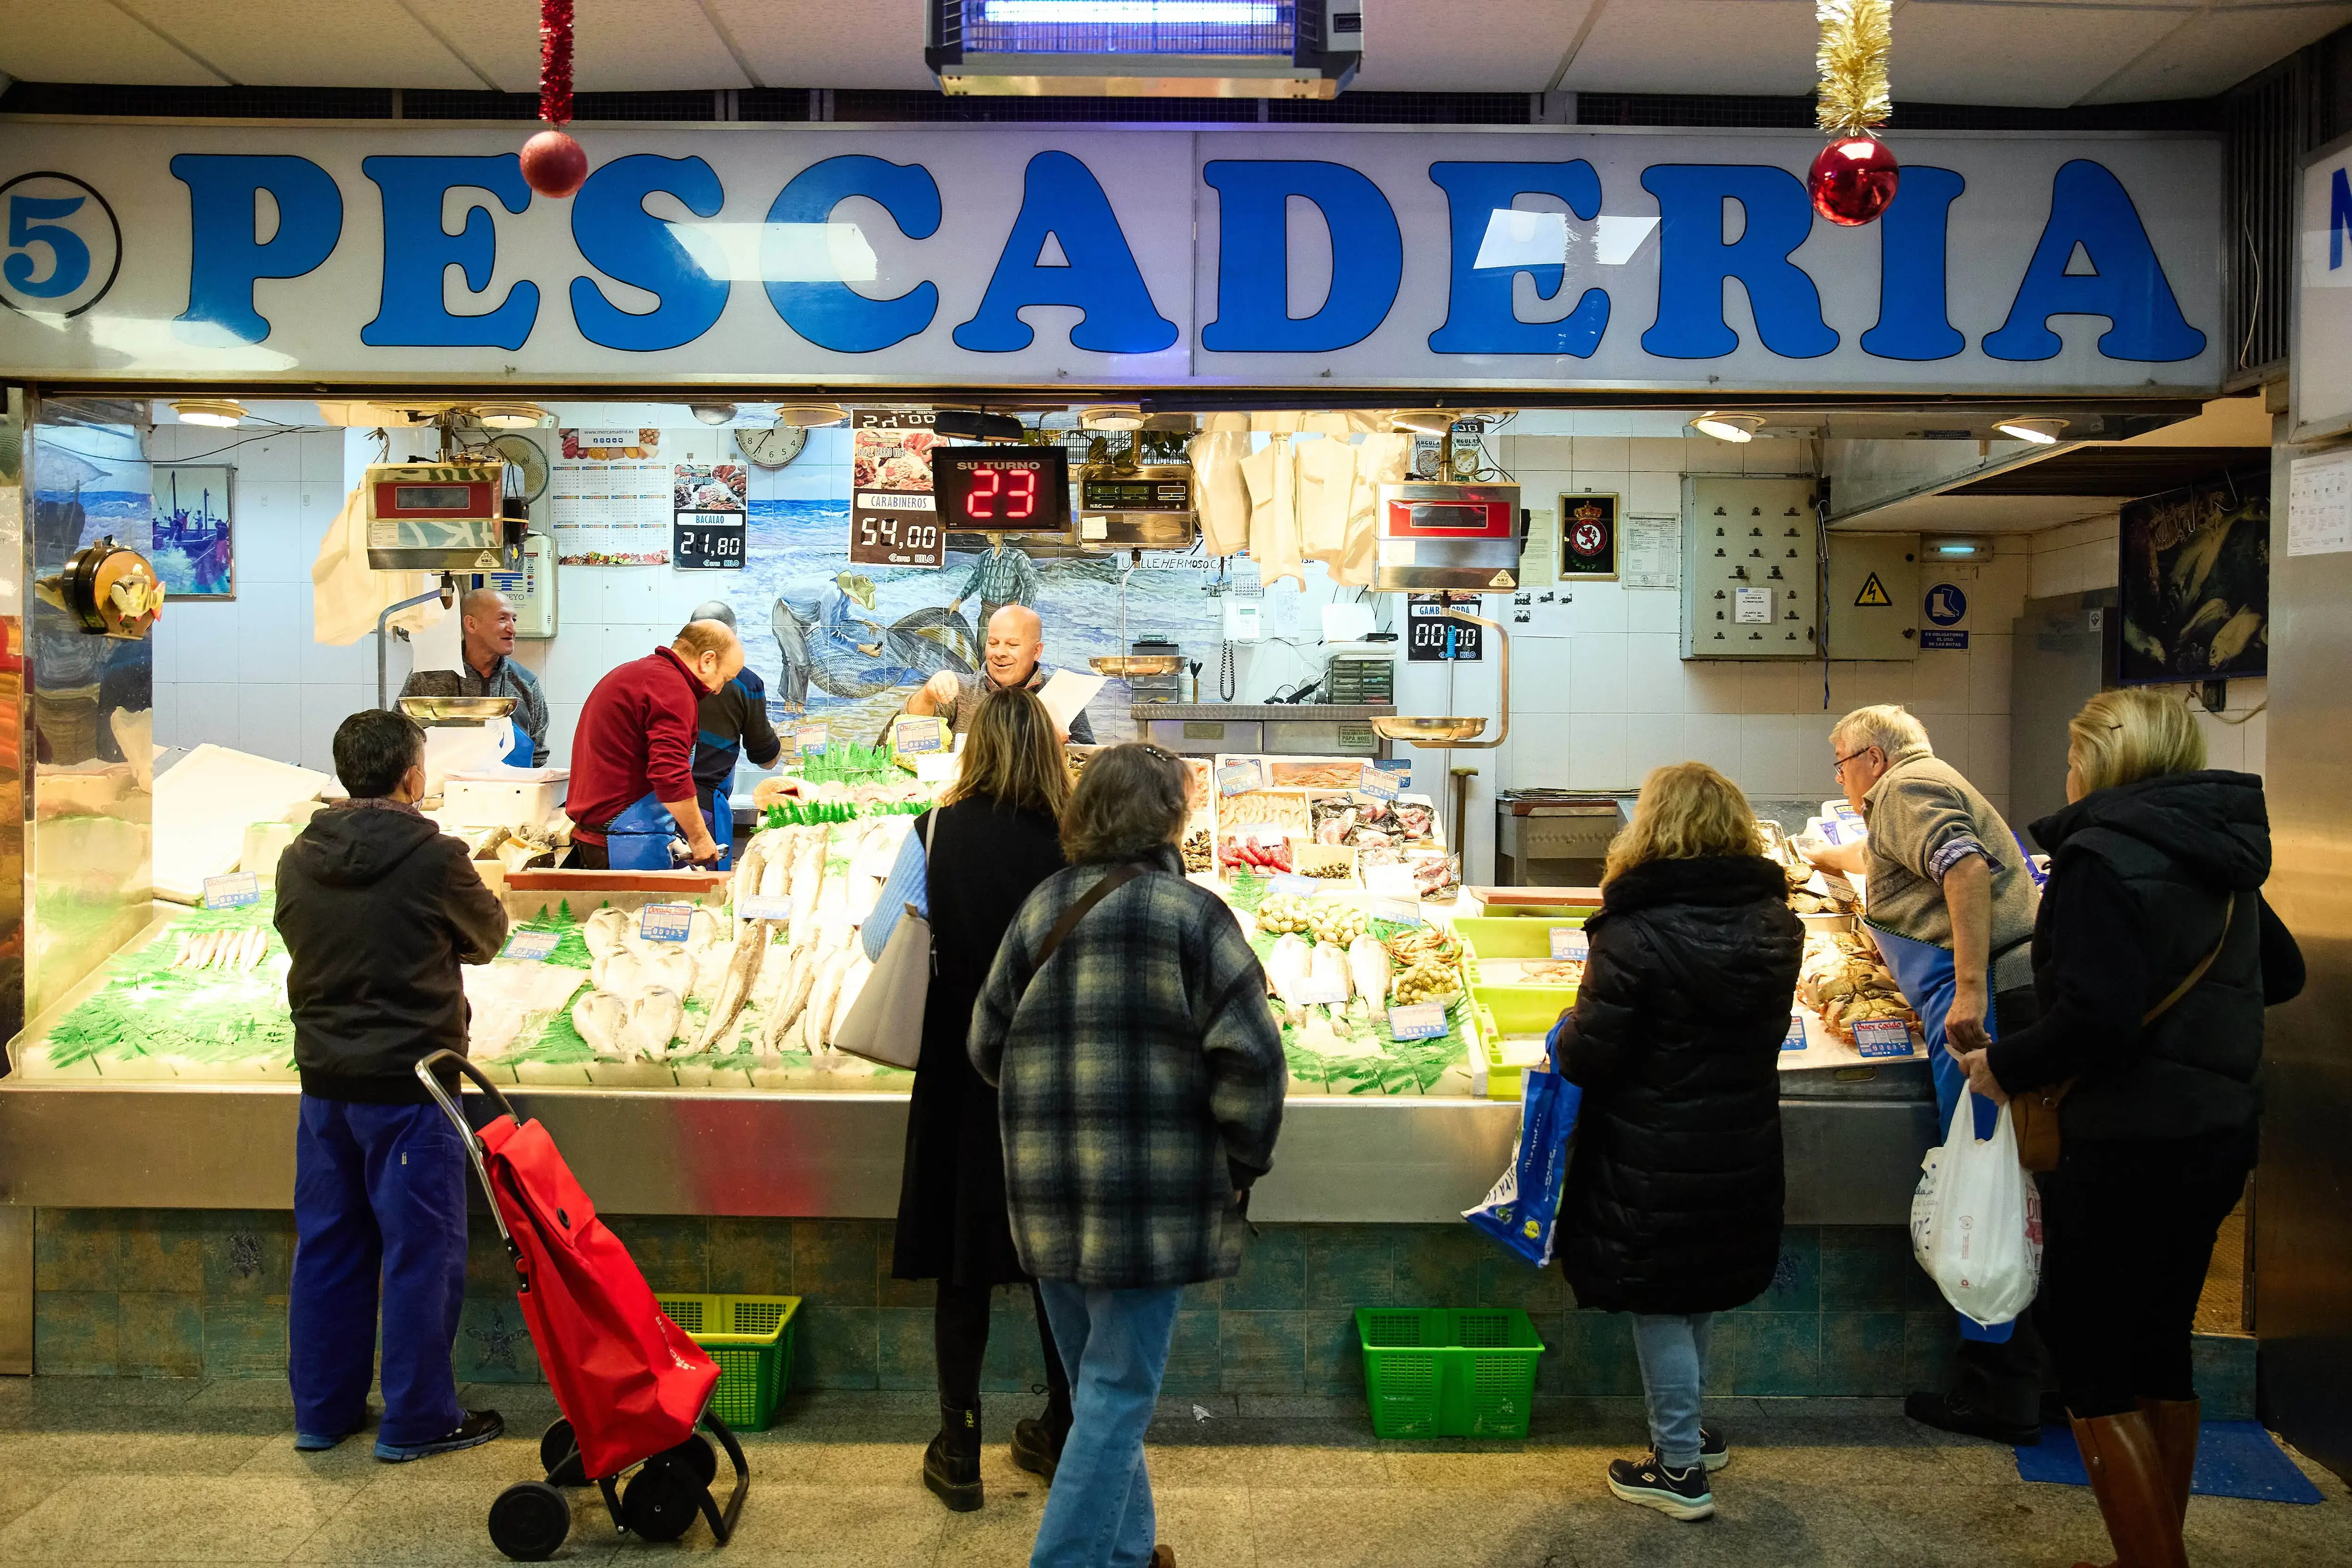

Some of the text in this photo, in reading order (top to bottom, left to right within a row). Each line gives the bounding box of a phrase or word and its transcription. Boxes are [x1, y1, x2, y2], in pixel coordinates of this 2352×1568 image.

[3, 196, 91, 298] 5
[170, 150, 2207, 363] PESCADERIA
[956, 462, 1041, 470] SU TURNO
[967, 470, 1035, 517] 23
[871, 496, 927, 508] CARABINEROS
[696, 515, 724, 524] BACALAO
[861, 517, 937, 549] 54,00
[680, 532, 740, 557] 21,80
[914, 554, 935, 564] KILO
[1419, 606, 1442, 614] GAMB
